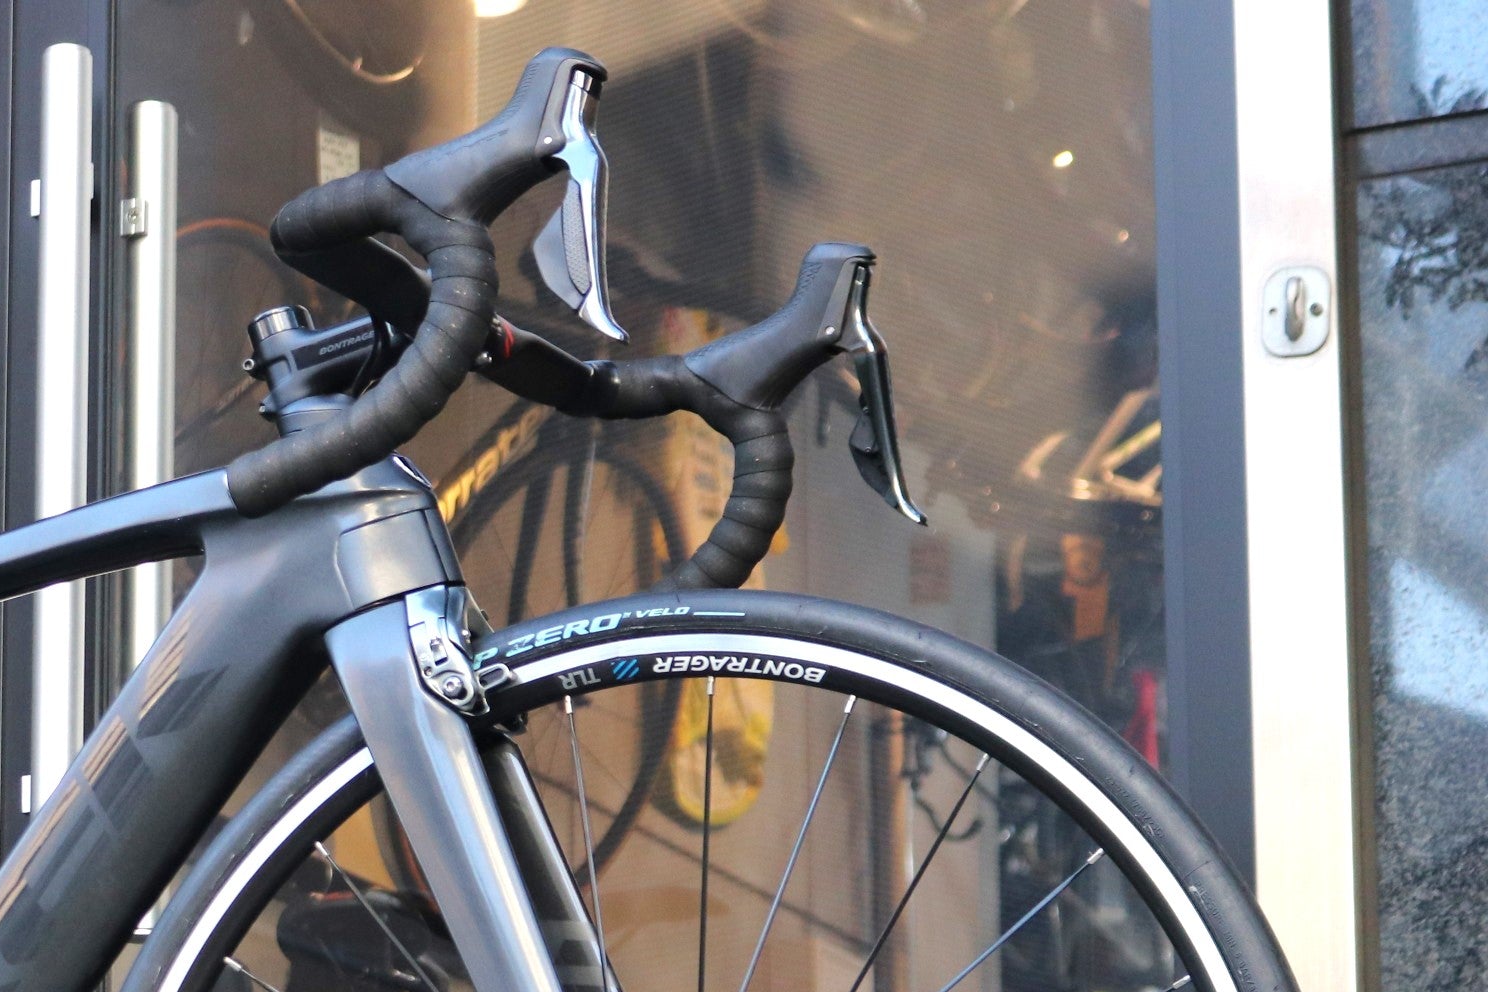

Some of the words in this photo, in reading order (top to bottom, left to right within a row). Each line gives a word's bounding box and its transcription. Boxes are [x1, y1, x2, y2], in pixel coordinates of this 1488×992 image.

[636, 606, 691, 618] VELO
[557, 666, 602, 691] TLR
[653, 655, 827, 684] BONTRAGER
